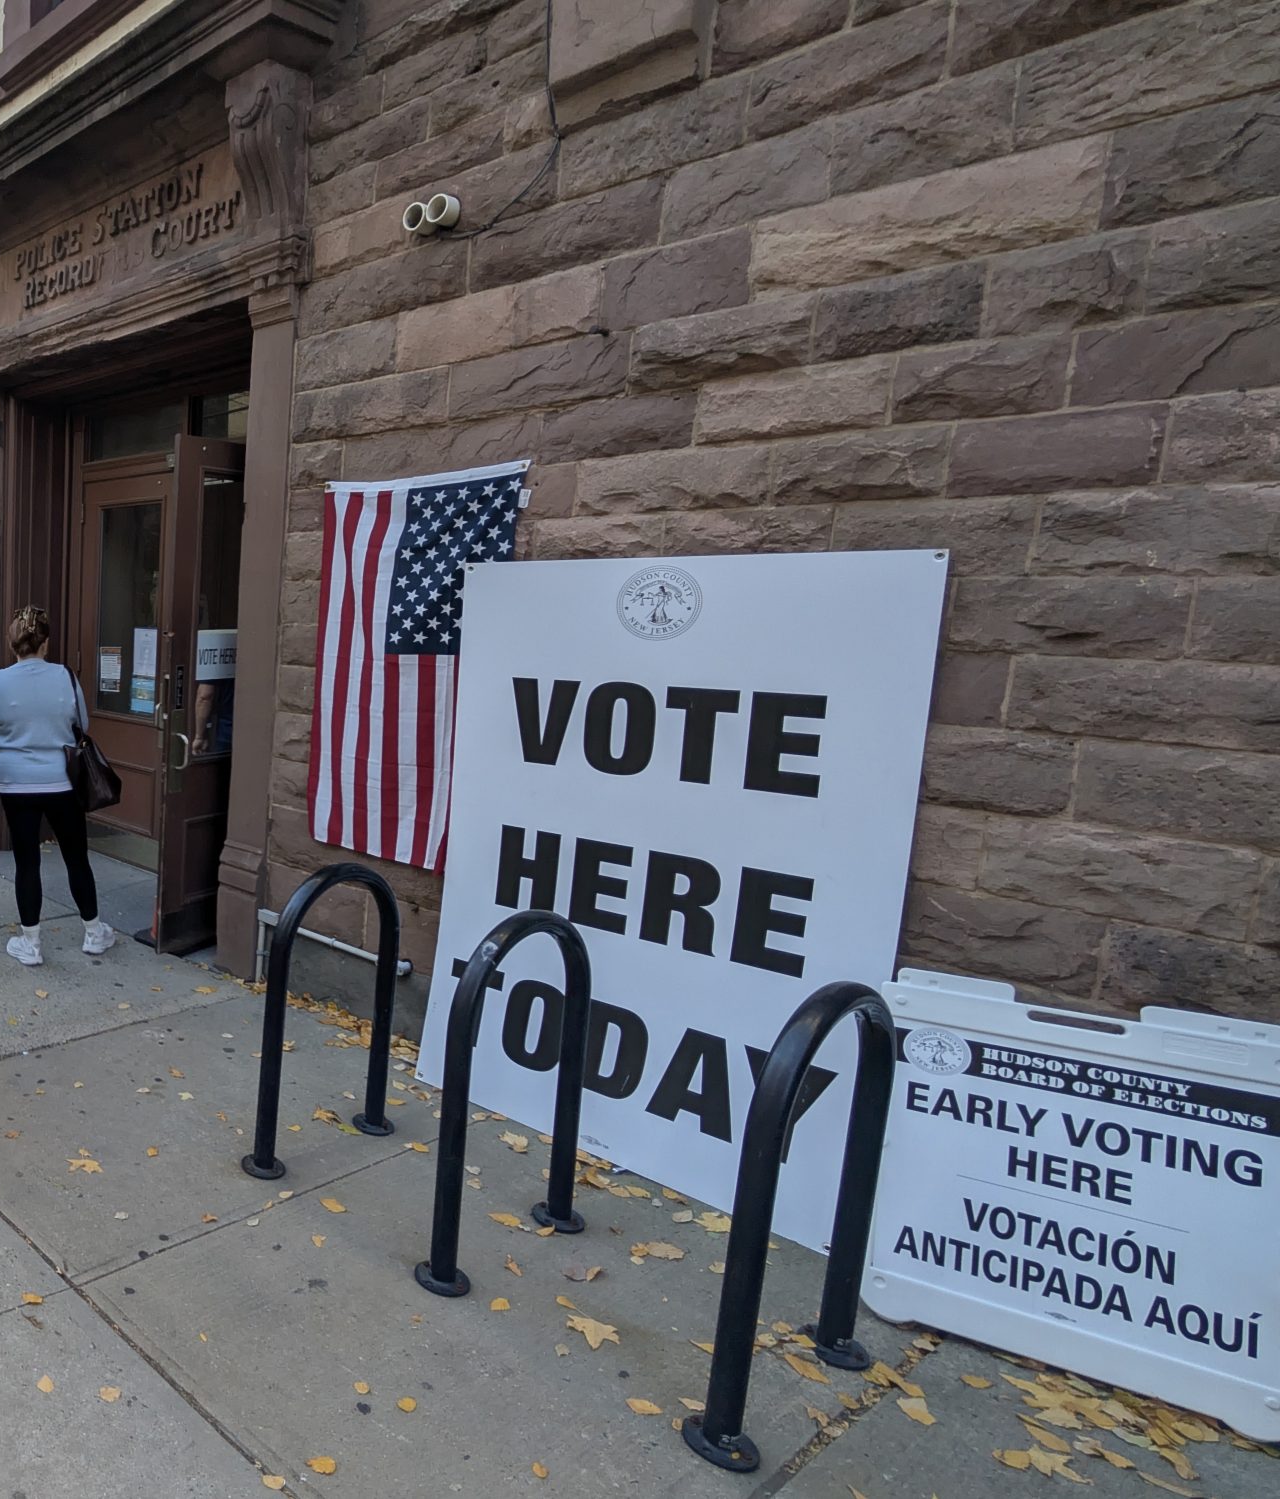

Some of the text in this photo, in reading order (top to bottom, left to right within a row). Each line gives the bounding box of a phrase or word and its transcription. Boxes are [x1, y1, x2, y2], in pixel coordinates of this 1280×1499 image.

[14, 163, 204, 281] POLICE STATION
[150, 190, 242, 259] COURT
[625, 572, 660, 597] HUDSON
[663, 572, 694, 597] COUNTY
[198, 648, 218, 665] VOTE
[628, 616, 685, 635] NEW JERSEY
[512, 677, 828, 798] VOTE
[495, 824, 815, 979] HERE
[981, 1062, 1268, 1130] BOARD OF ELECTIONS
[982, 1047, 1192, 1097] HUDSON COUNTY
[905, 1080, 1263, 1188] EARLY VOTING
[1007, 1145, 1133, 1206] HERE
[962, 1197, 1176, 1286] VOTACIÓN
[893, 1225, 1264, 1359] ANTICIPADA AQUÍ
